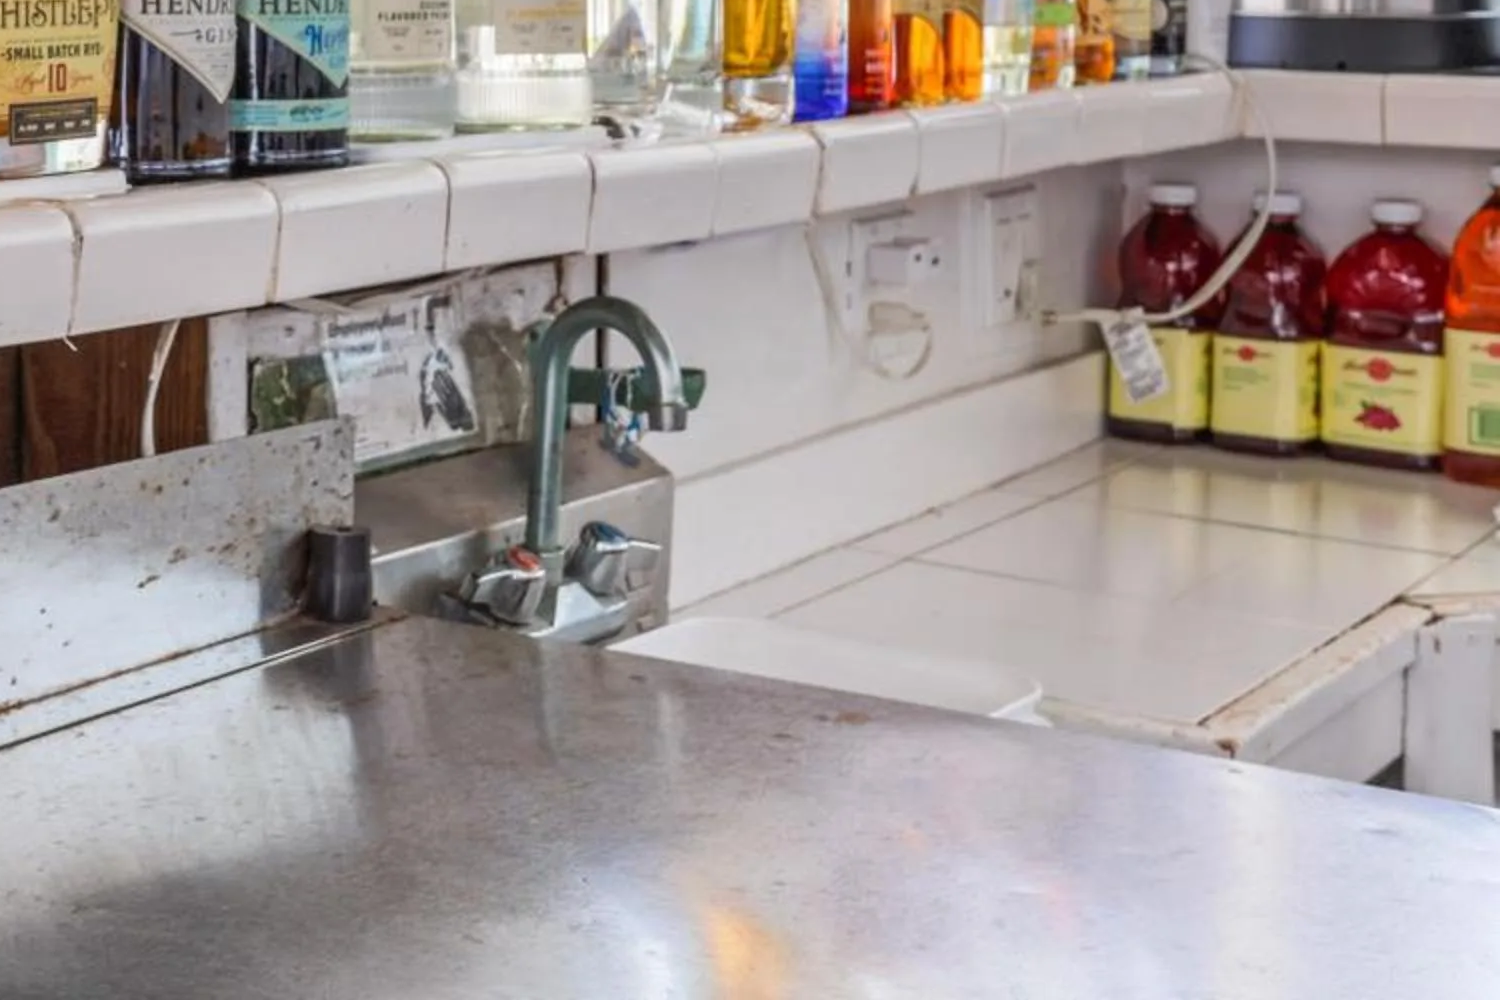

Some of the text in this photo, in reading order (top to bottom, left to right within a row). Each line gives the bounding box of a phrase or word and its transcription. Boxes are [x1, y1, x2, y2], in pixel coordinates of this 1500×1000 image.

[5, 47, 43, 61] SMALL
[46, 44, 80, 59] BATCH
[47, 63, 67, 93] 10
